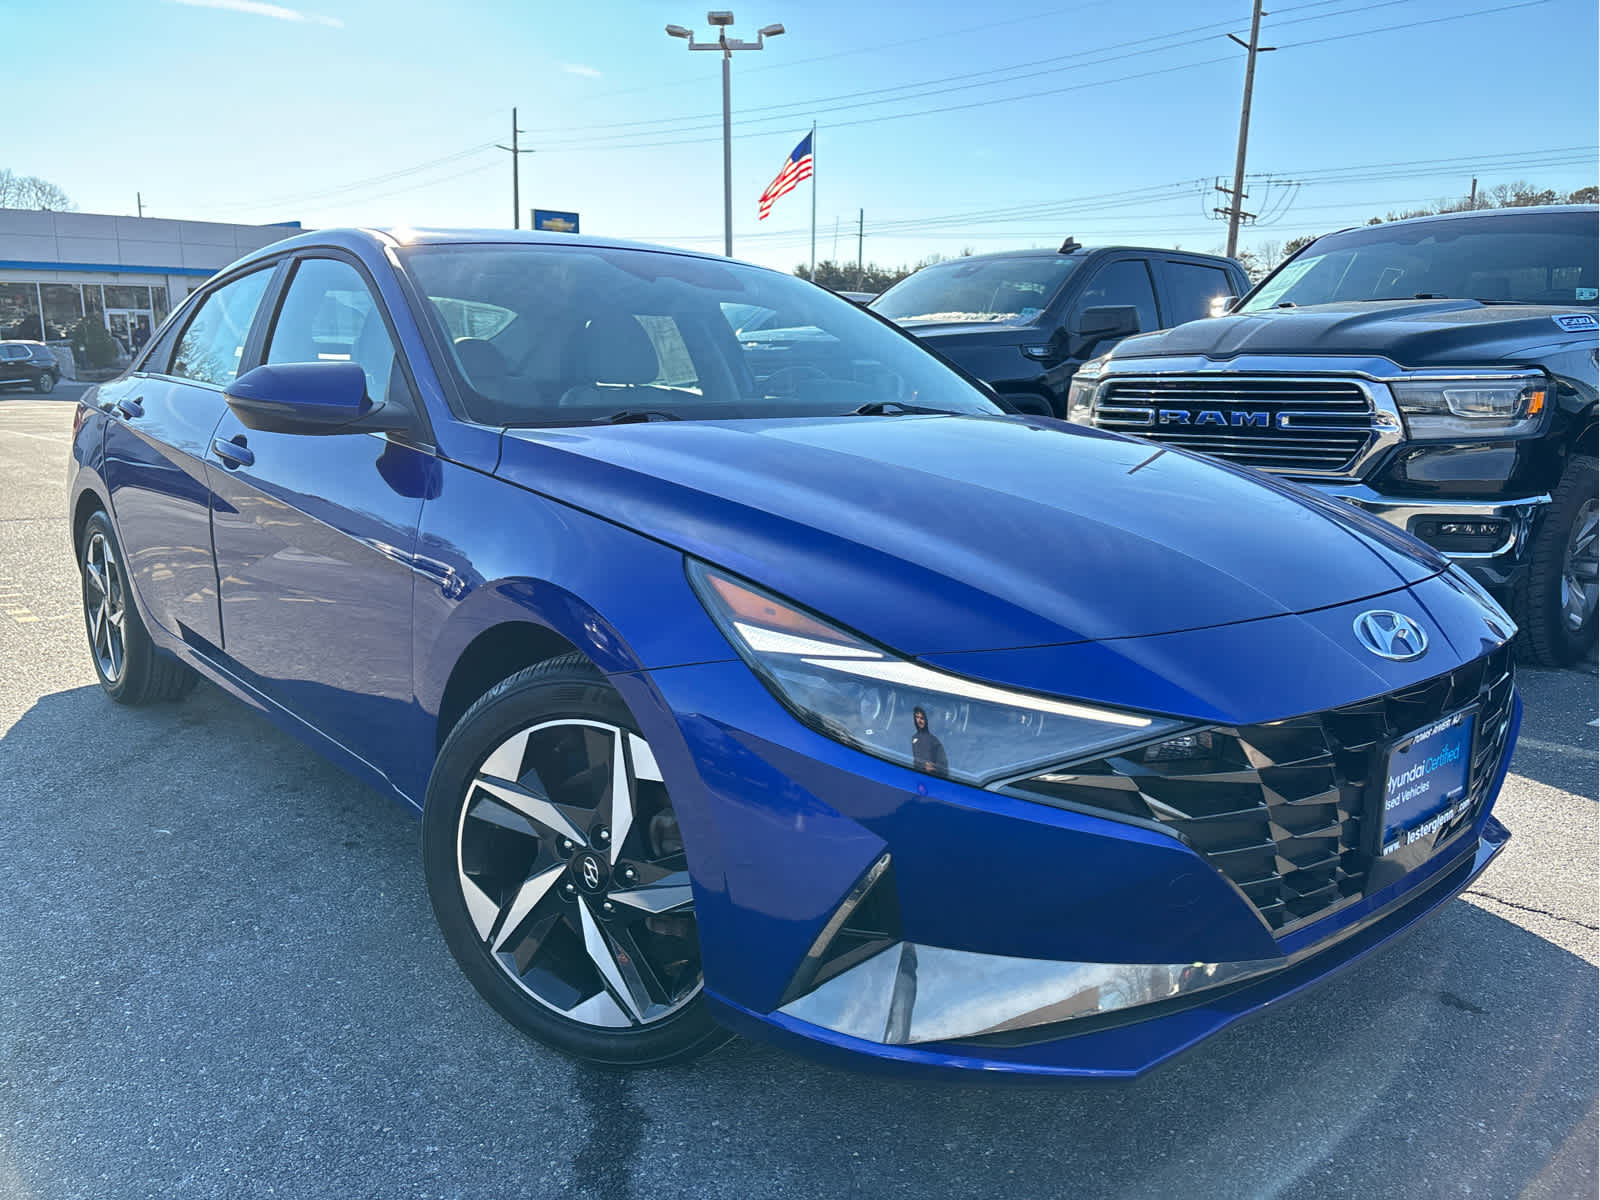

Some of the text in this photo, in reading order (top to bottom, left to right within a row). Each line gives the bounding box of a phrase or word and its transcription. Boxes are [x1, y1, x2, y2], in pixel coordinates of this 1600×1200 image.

[1159, 409, 1268, 428] RAM
[1425, 743, 1460, 774] Certified
[1401, 781, 1430, 803] Vehicles
